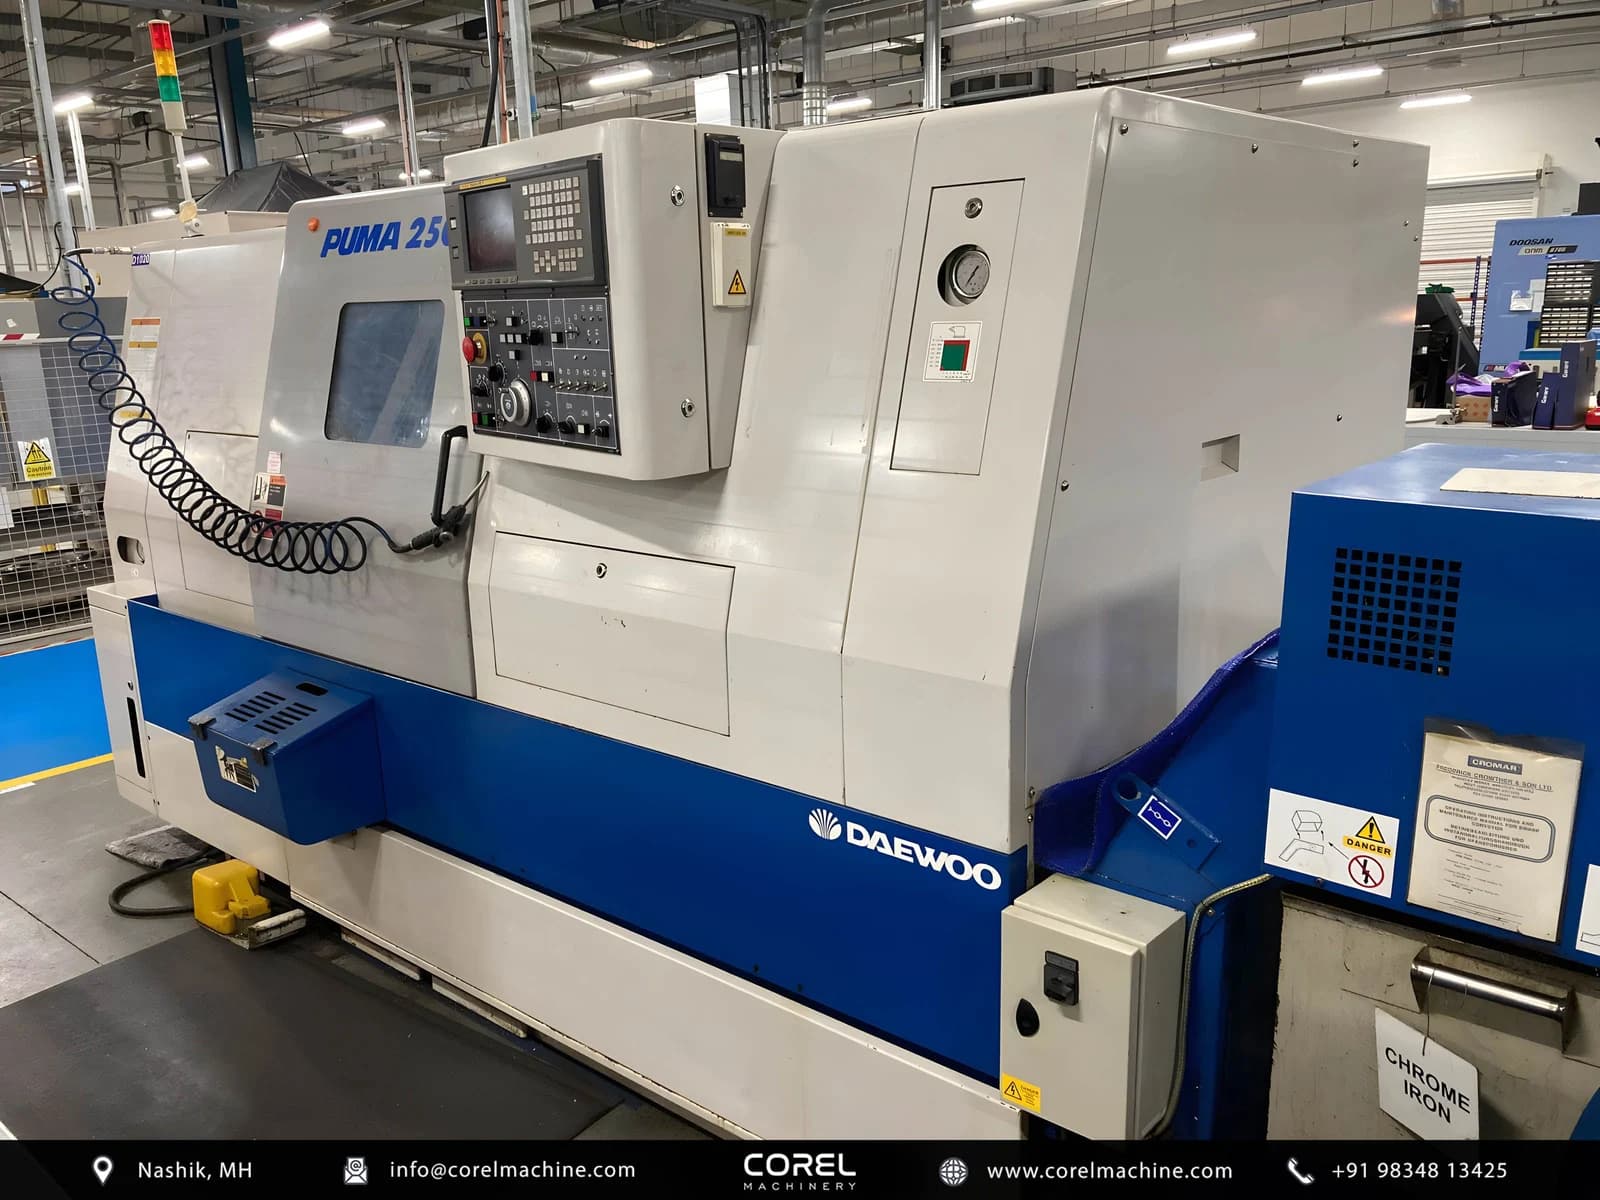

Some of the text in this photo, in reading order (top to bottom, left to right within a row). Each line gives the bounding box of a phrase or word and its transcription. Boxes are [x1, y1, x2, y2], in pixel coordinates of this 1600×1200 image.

[320, 221, 401, 258] PUMA
[1509, 237, 1554, 246] DOOSAN
[26, 465, 52, 473] Caution
[1471, 758, 1518, 772] CROMAR
[1473, 772, 1513, 784] CROWTHER
[1522, 781, 1537, 790] SON
[846, 821, 1002, 890] DAEWOO
[1346, 838, 1391, 856] DANGER
[1385, 1047, 1471, 1114] CHROME
[1404, 1079, 1451, 1124] IRON
